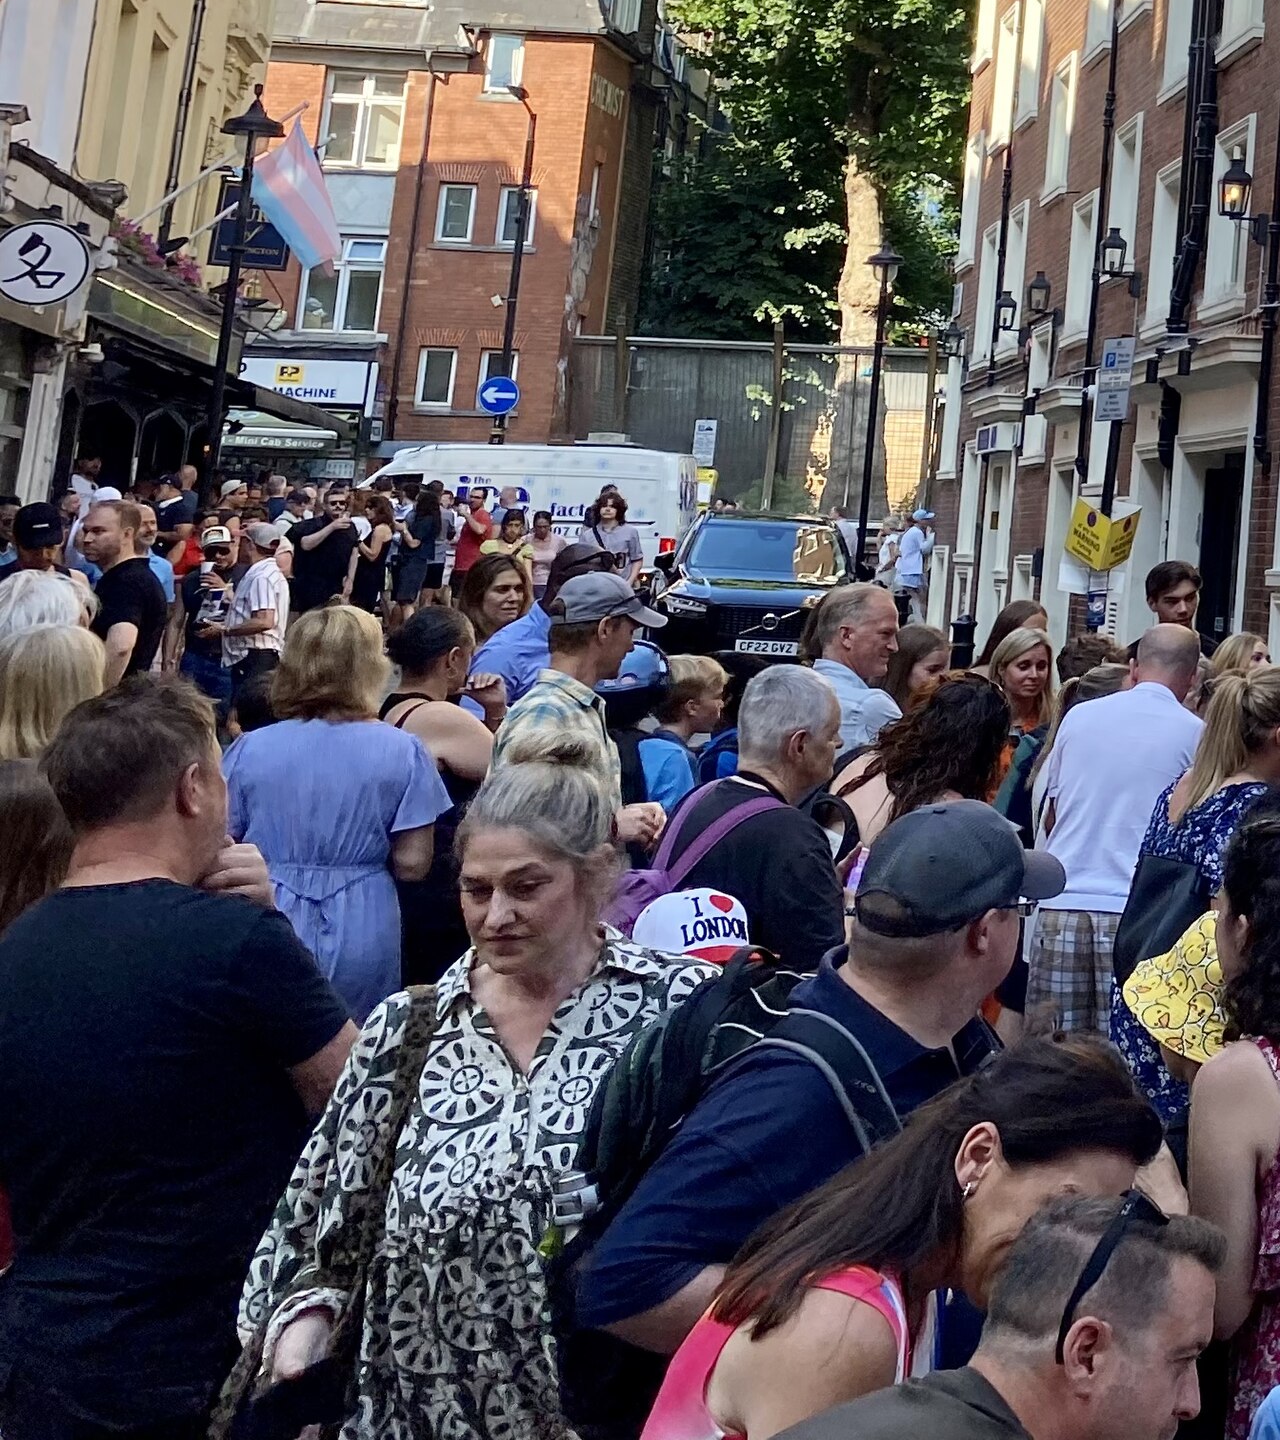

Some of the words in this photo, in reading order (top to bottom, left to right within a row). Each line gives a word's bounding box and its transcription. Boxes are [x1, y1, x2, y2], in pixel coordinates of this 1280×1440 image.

[235, 436, 258, 445] Mini
[260, 437, 281, 447] Cab
[284, 438, 325, 449] Service
[551, 502, 587, 517] fact
[739, 641, 769, 653] CF22
[691, 897, 703, 917] I
[681, 916, 748, 947] LONDON
